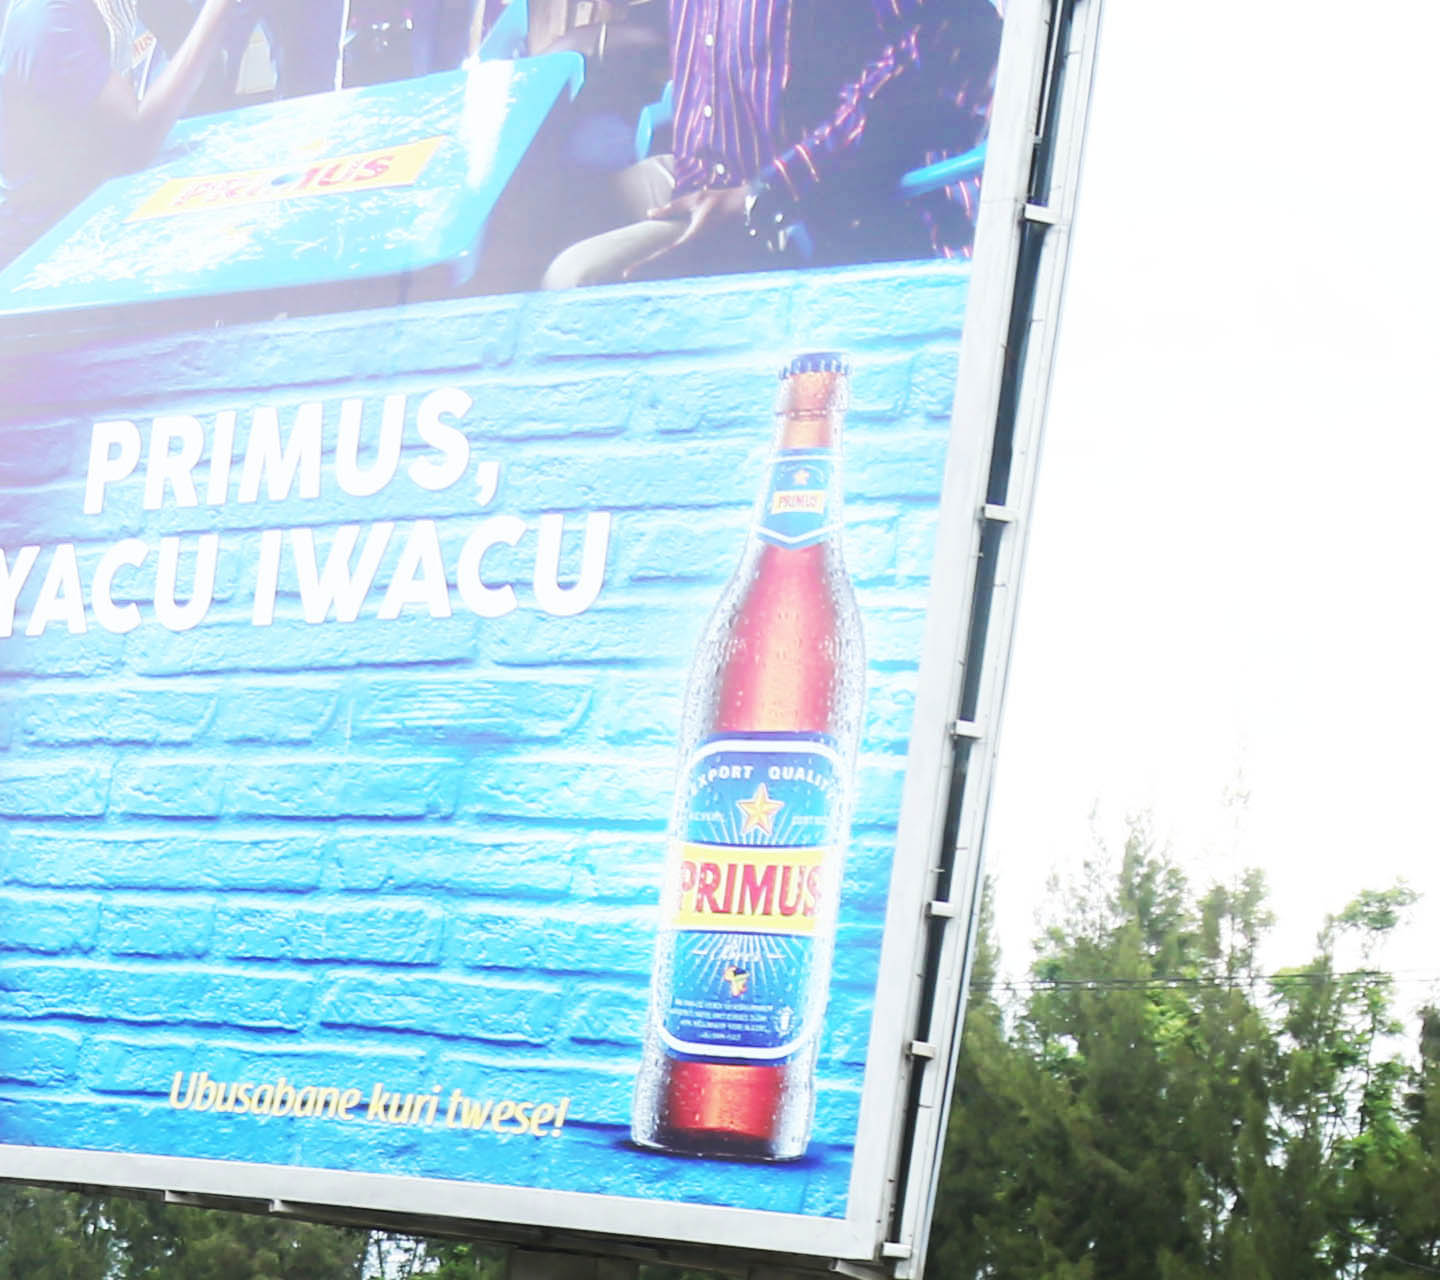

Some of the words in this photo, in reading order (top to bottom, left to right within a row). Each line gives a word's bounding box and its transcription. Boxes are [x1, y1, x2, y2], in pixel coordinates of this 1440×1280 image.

[82, 386, 500, 516] PRIMUS,
[251, 510, 612, 628] IWACU
[679, 860, 823, 918] PRIMUS
[168, 1070, 362, 1121] Ubusabane
[367, 1082, 443, 1126] kuri
[446, 1086, 571, 1138] twese!
